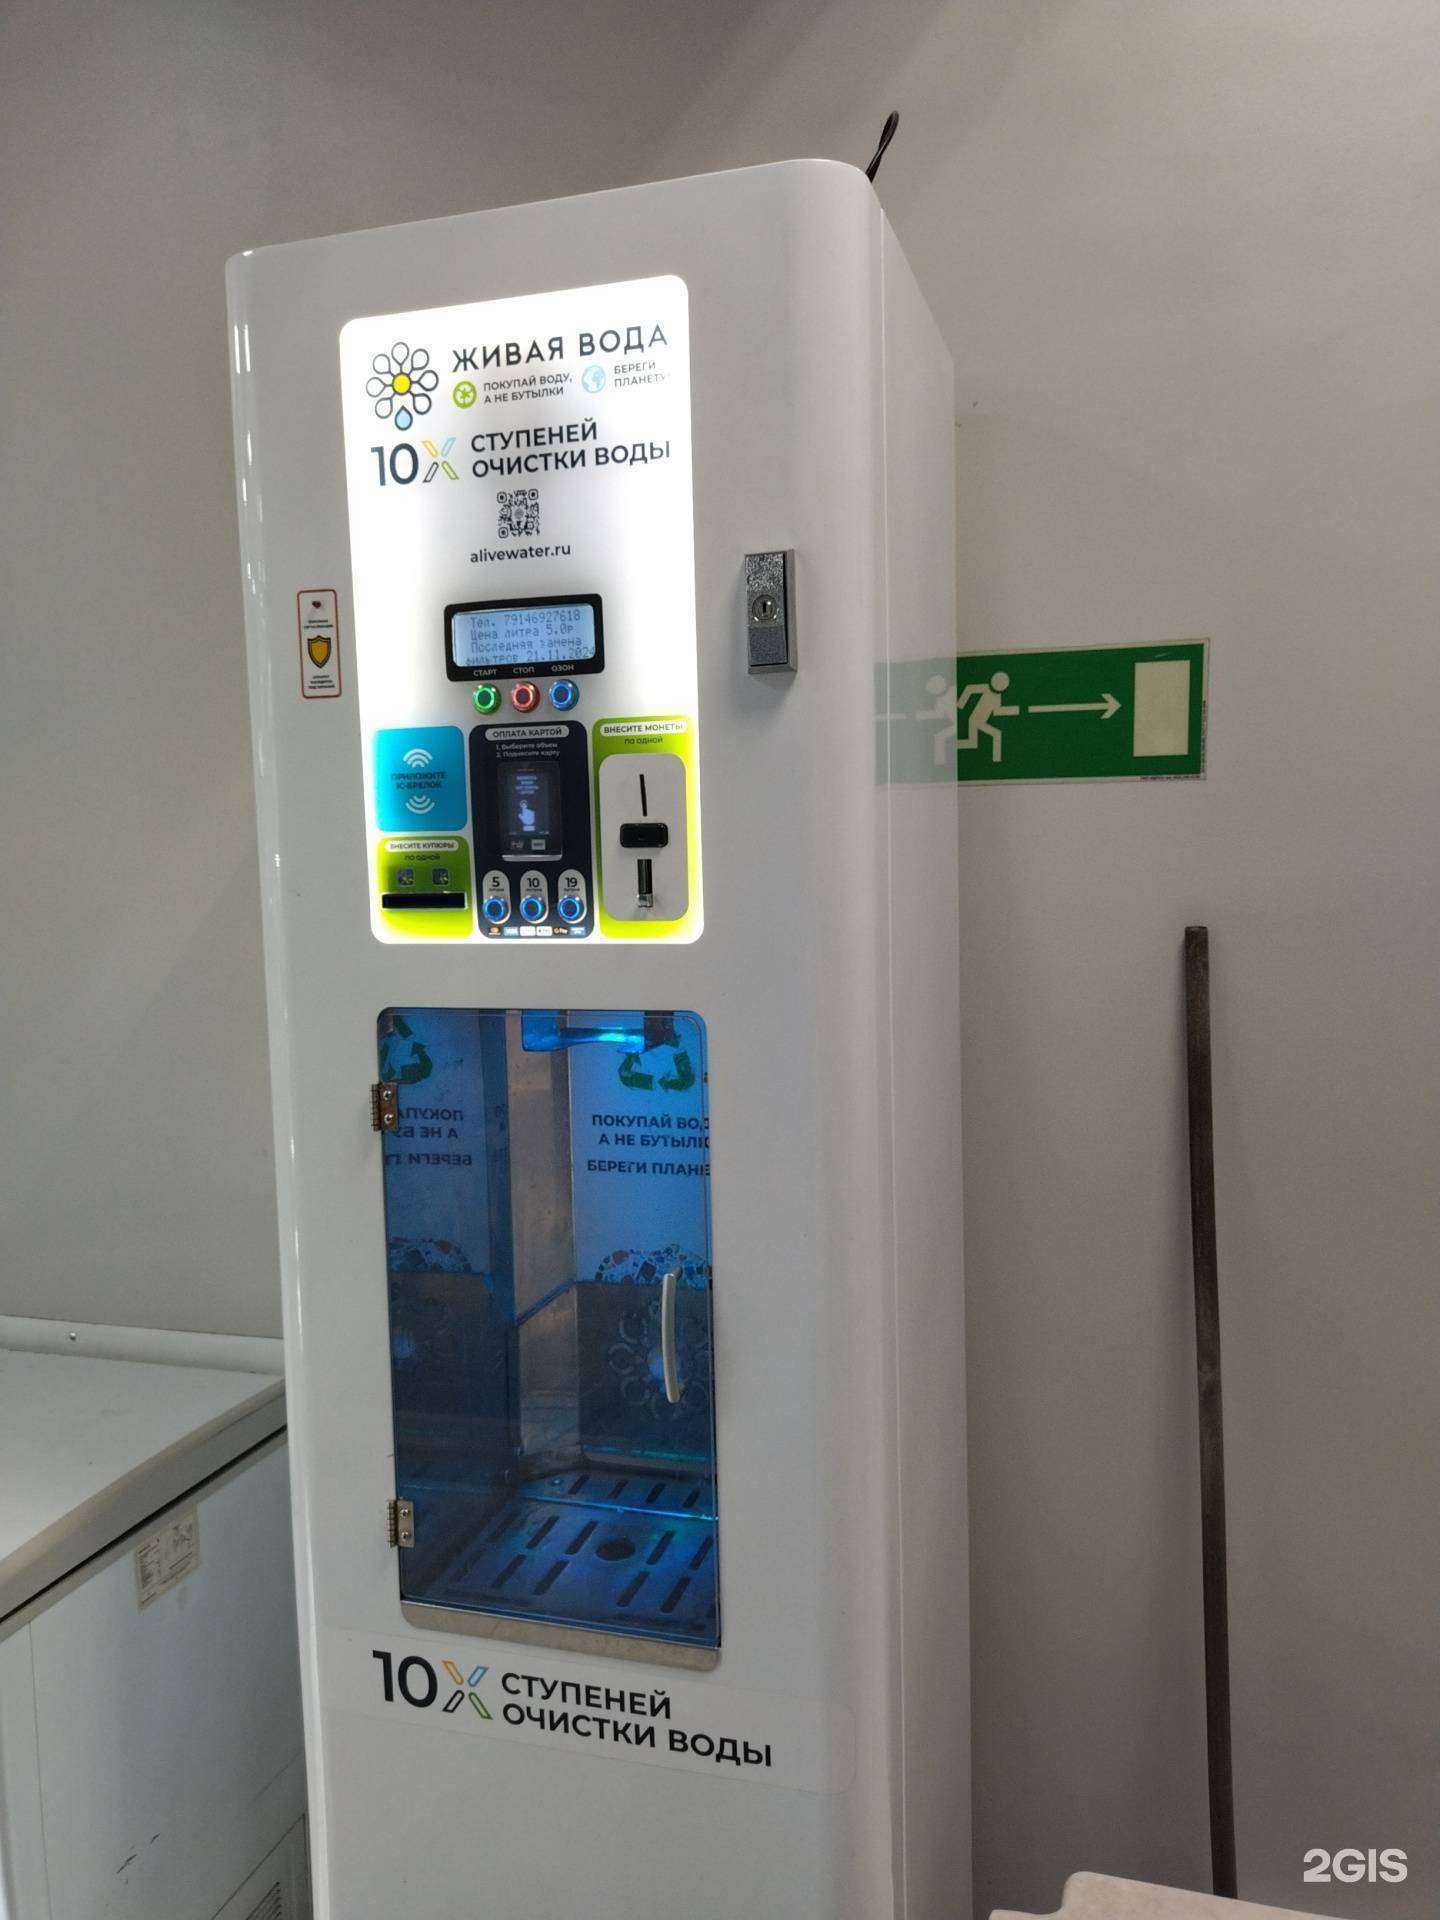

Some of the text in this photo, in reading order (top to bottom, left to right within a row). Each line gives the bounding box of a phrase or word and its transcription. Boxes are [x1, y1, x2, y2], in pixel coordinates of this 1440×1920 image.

[452, 324, 668, 372] ЖИВАЯ ВОДА
[614, 361, 656, 374] БЕРЕГИ
[484, 373, 573, 392] ПОКУПАЙ ВОДУ,
[484, 386, 564, 404] А НЕ БУТЫЛКИ
[471, 417, 598, 453] СТУПЕНЕЙ
[472, 440, 671, 478] ОЧИСТКИ ВОДЫ
[470, 544, 571, 563] alivewater.ru
[473, 669, 498, 677] СТАРТ
[513, 667, 535, 675] СТОП
[551, 664, 575, 672] ОЗОН
[493, 727, 562, 738] ОПЛАТА КАРТОЙ
[603, 723, 683, 734] ВНЕСИТЕ МОНЕТЫ
[492, 877, 500, 887] 5
[527, 877, 540, 888] 10
[565, 877, 578, 888] 19
[592, 1113, 672, 1129] ПОКУПАЙ
[598, 1133, 610, 1145] А
[614, 1133, 635, 1146] НЕ
[587, 1160, 647, 1174] БЕРЕГИ
[502, 1672, 672, 1720] СТУПЕНЕЙ
[503, 1703, 772, 1767] ОЧИСТКИ ВОДЫ
